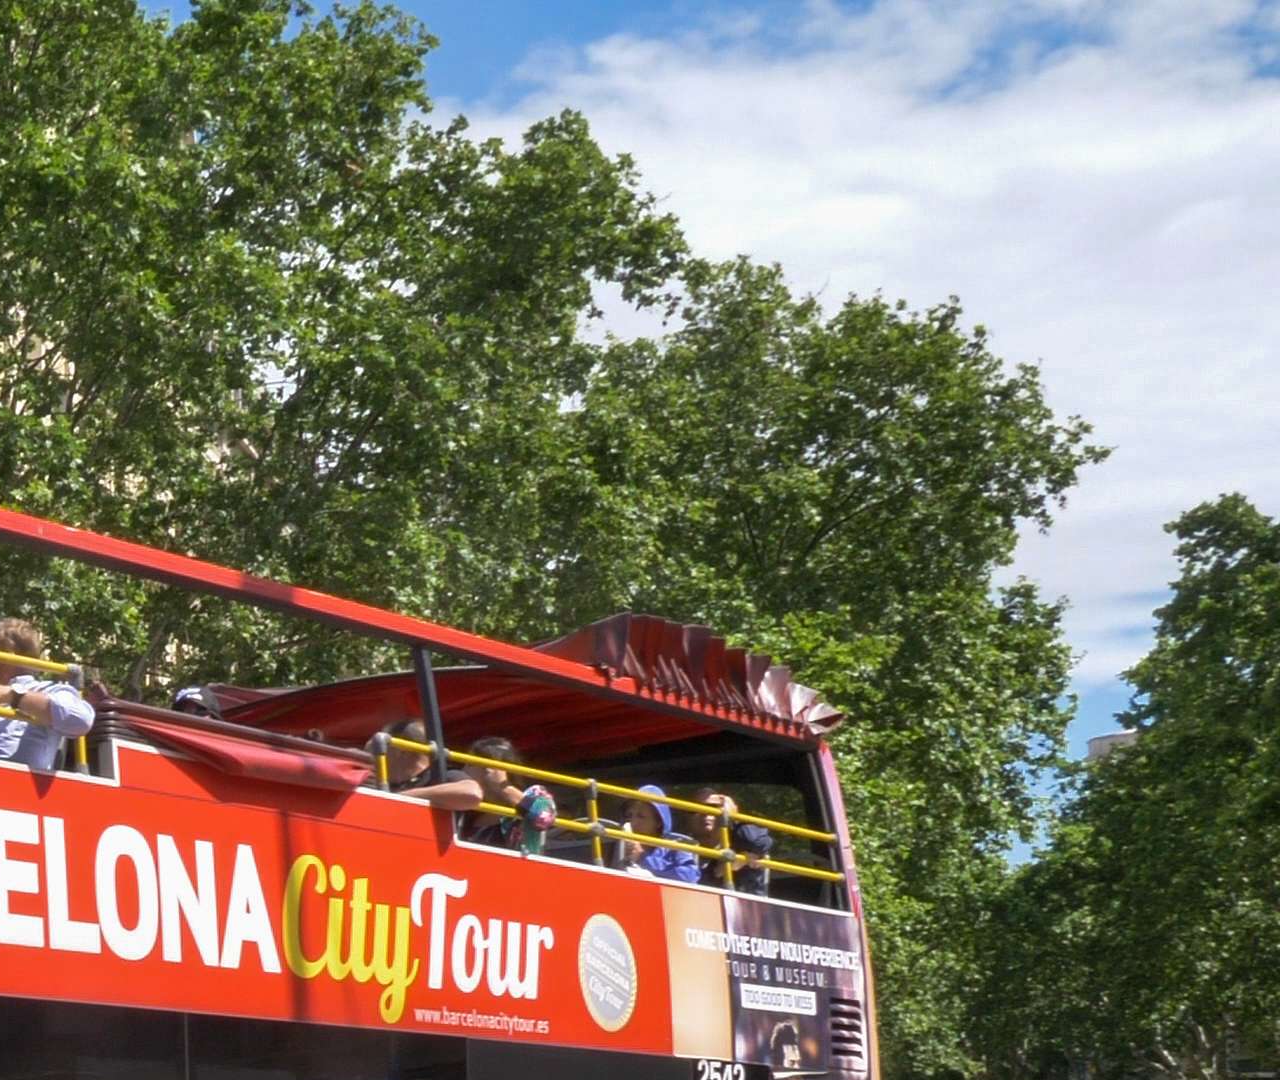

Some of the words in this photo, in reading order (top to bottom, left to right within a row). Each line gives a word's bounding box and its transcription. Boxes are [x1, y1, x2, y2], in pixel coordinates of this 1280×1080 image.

[685, 927, 716, 951] COME
[716, 931, 730, 953] TO
[729, 934, 751, 956] THE
[751, 937, 779, 960] CAMP
[780, 941, 802, 964] NOU
[802, 944, 860, 971] EXPERIENCE
[727, 960, 758, 980] TOUR
[762, 964, 770, 981] &
[775, 966, 825, 988] MUSEUM
[414, 1006, 550, 1035] www.barcelonacitytour.es
